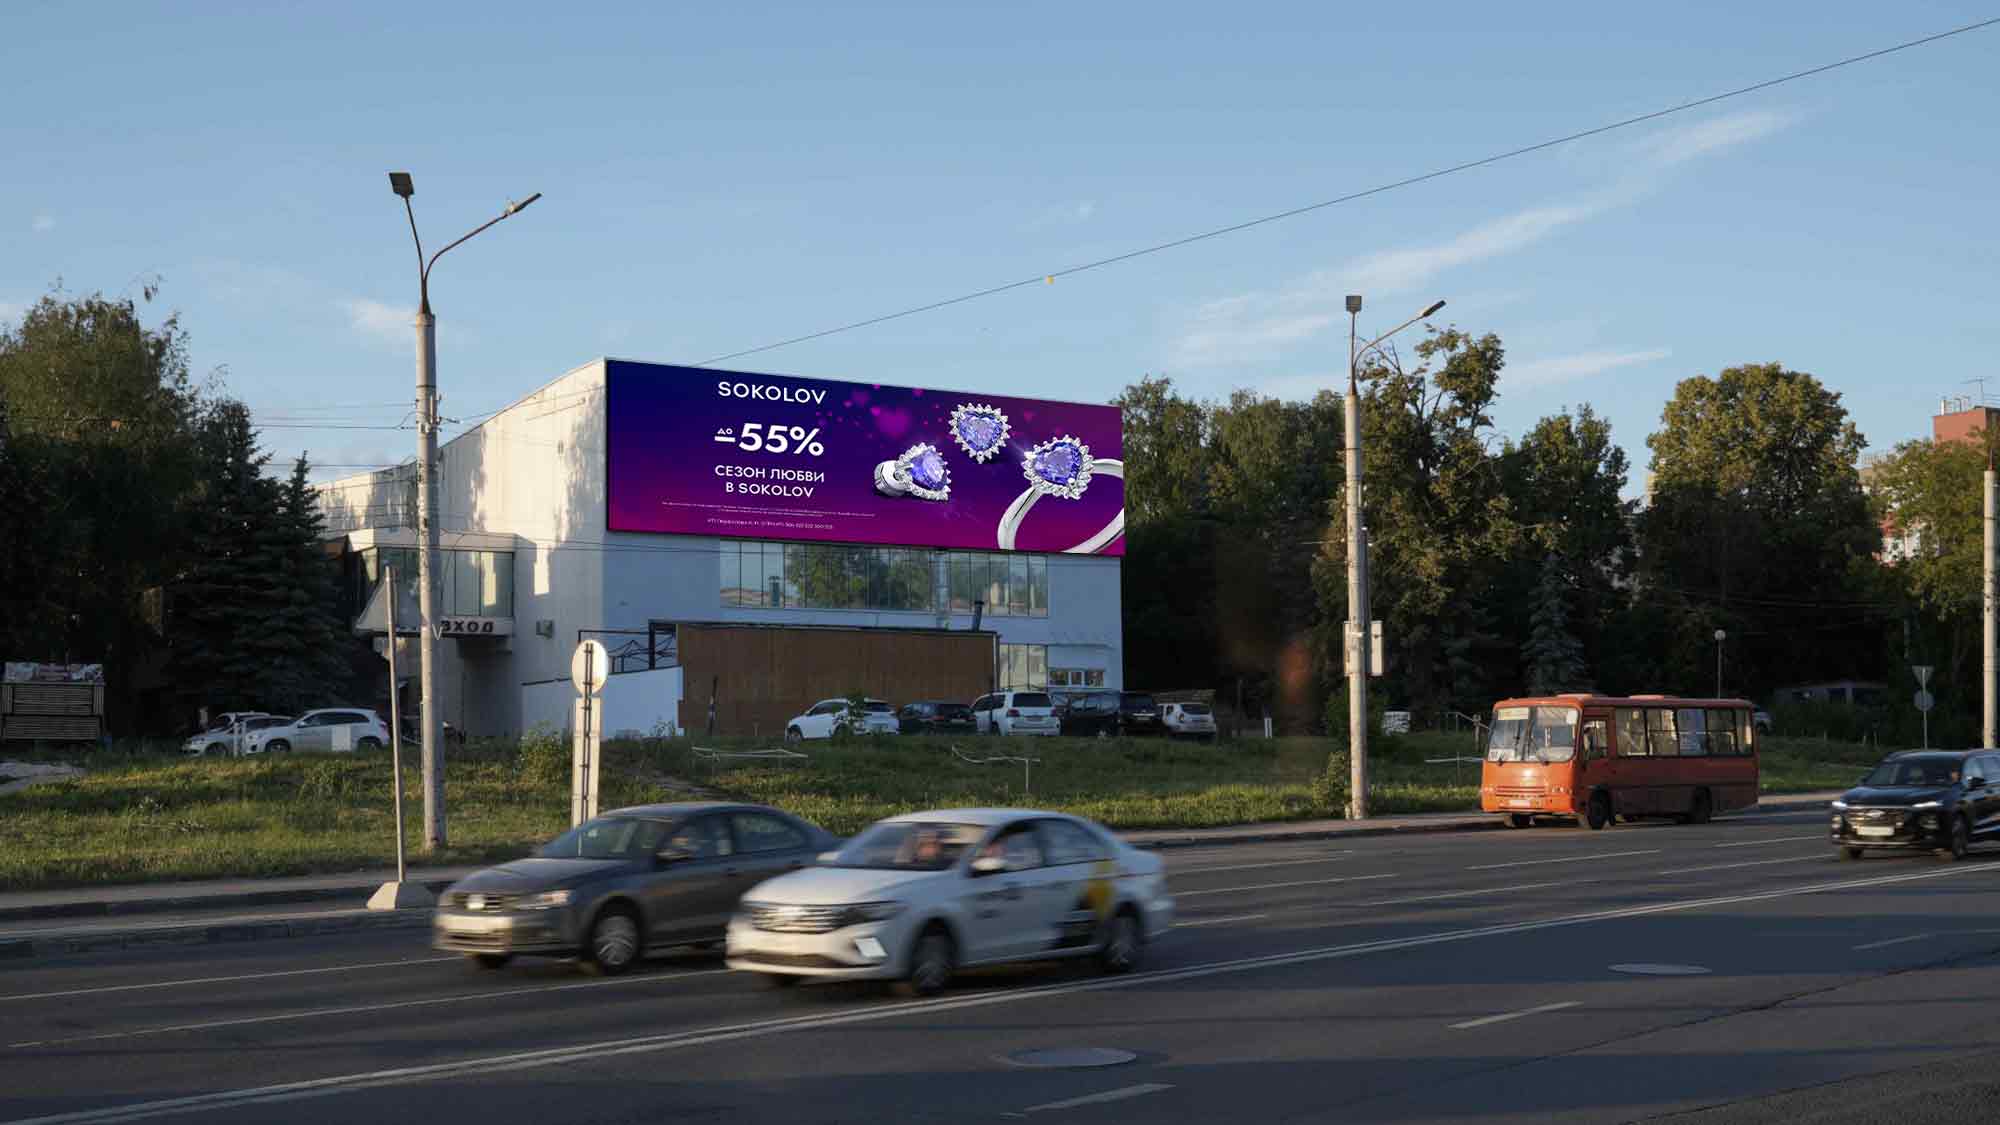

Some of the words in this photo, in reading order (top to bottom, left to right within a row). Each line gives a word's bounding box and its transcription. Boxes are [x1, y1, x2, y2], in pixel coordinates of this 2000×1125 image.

[718, 381, 826, 404] SOKOLOV
[715, 465, 766, 479] СЕЗОН
[770, 468, 825, 483] ЛЮБВИ
[738, 483, 814, 498] SOKOLOV
